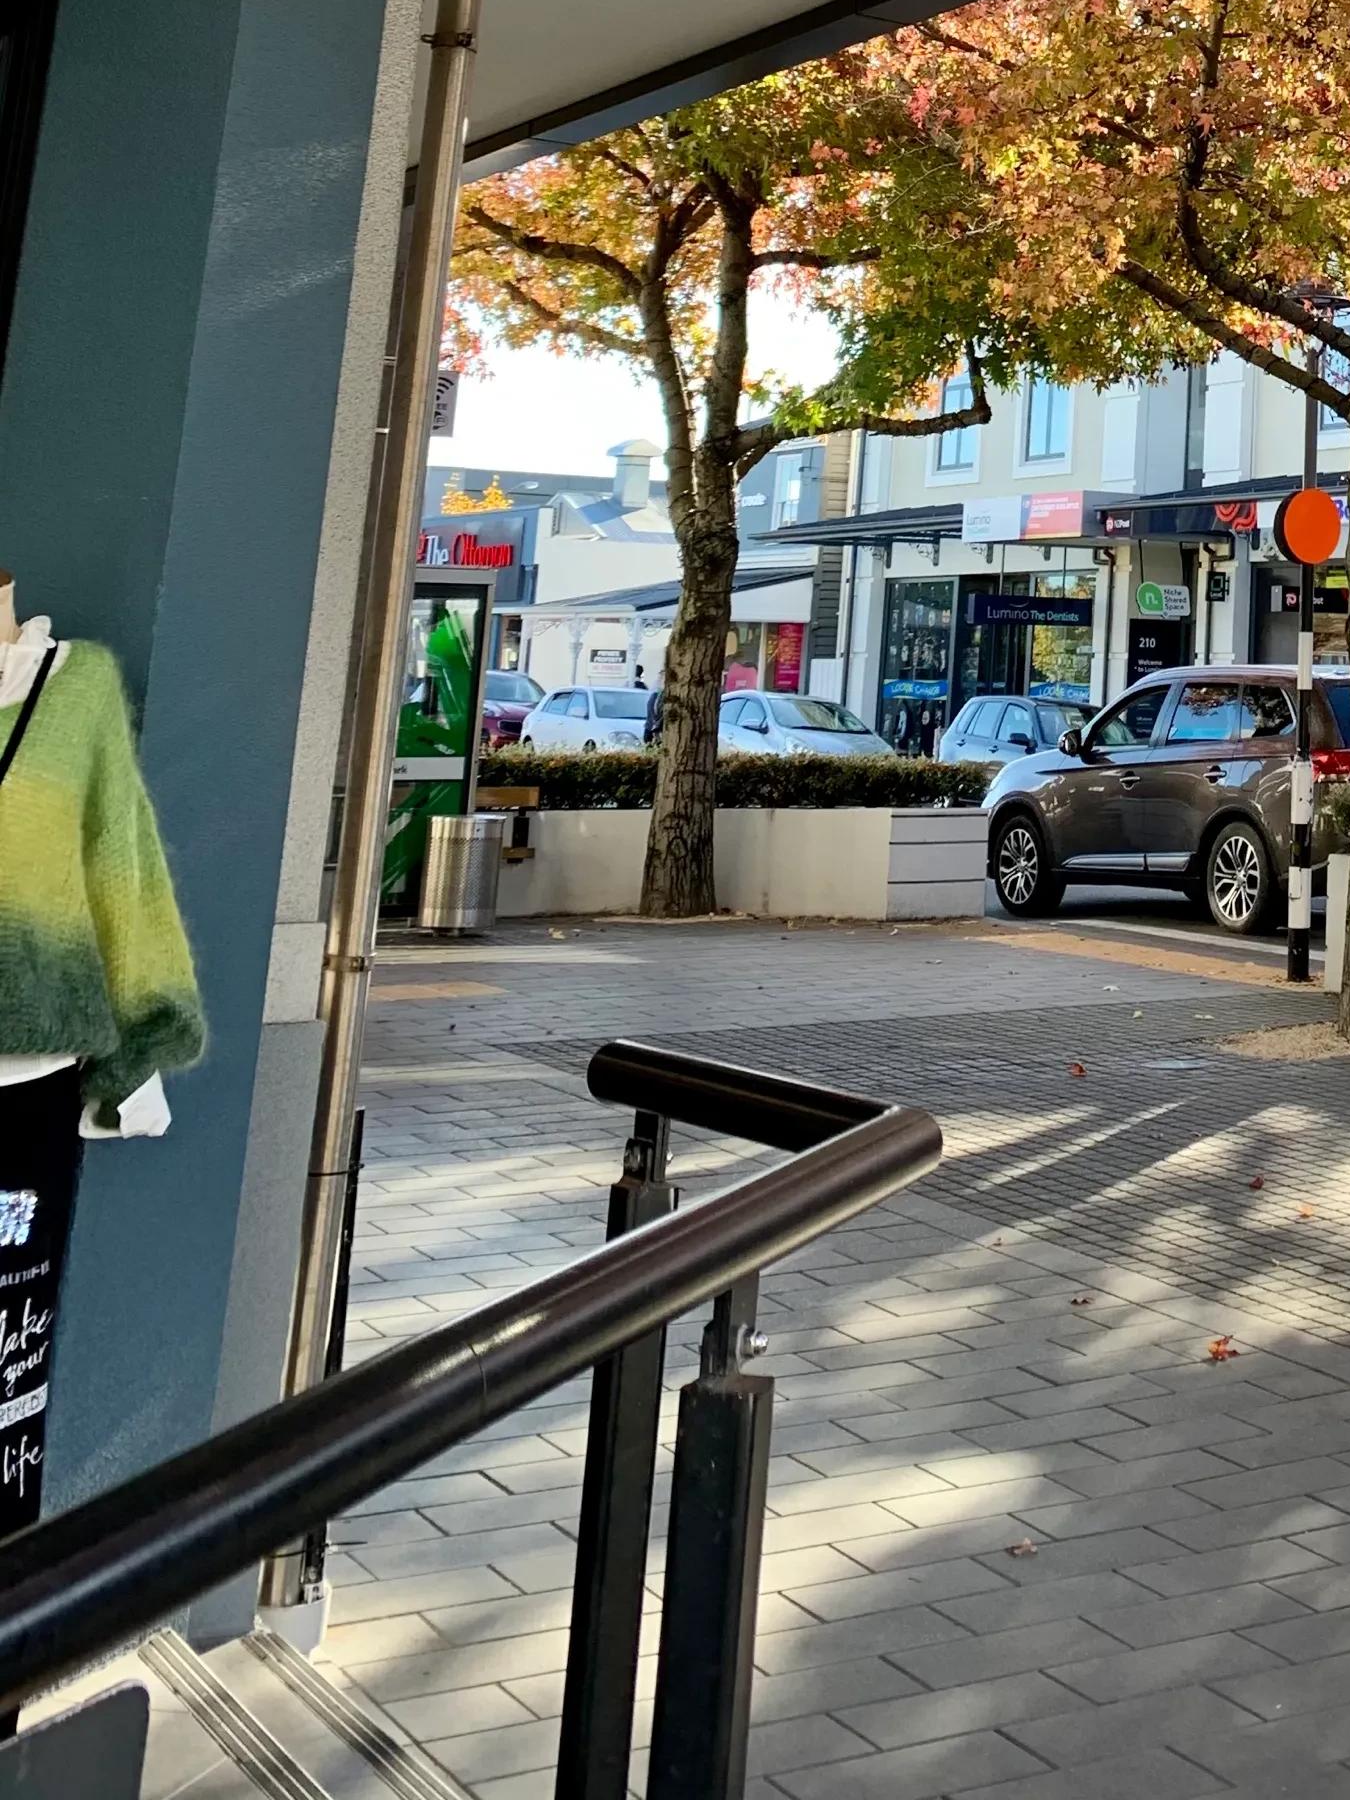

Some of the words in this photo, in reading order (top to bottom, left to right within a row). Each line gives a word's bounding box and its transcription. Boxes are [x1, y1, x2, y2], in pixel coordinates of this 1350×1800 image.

[426, 535, 449, 565] The
[987, 606, 1029, 619] Lumino
[1029, 610, 1046, 620] The
[1139, 638, 1156, 648] 210
[3, 1435, 44, 1498] life
